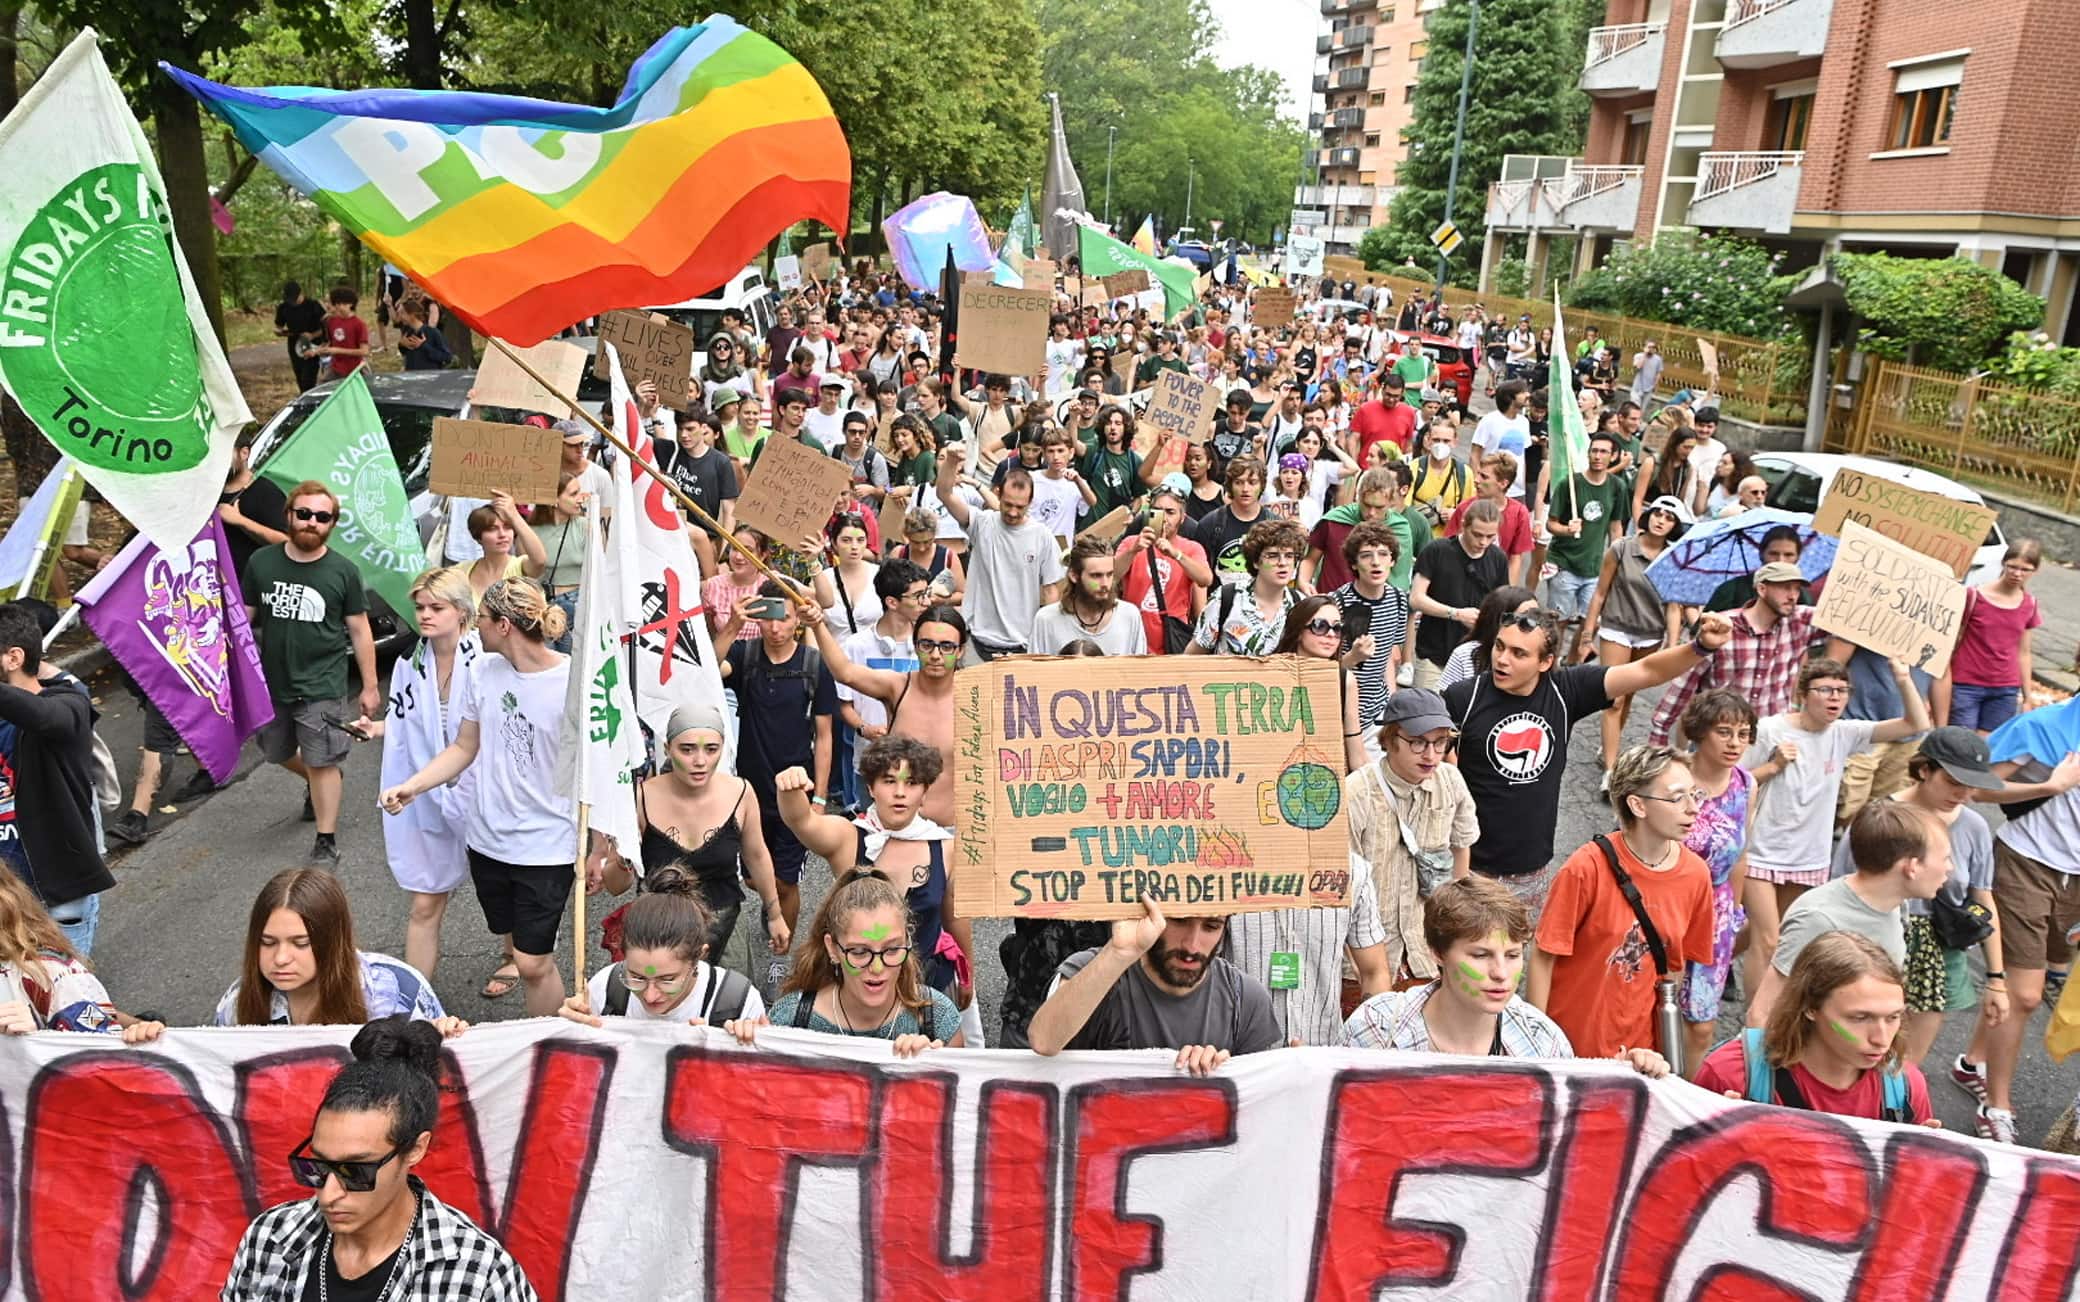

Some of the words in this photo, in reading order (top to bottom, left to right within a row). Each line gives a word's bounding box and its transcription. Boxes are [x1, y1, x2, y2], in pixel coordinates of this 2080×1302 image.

[0, 176, 122, 348] FRIDAYS
[646, 350, 675, 369] OVER
[1167, 392, 1179, 408] TO
[51, 385, 173, 463] Torino
[1832, 472, 1863, 498] NO
[261, 590, 300, 608] NORD
[272, 580, 304, 598] THE
[271, 604, 300, 621] EST
[1004, 673, 1043, 741] IN
[1049, 683, 1201, 740] QUESTA
[1202, 681, 1315, 736] TERRA
[999, 747, 1033, 782] DI
[1037, 741, 1127, 781] ASPRI
[1009, 870, 1086, 906] STOP
[1104, 870, 1180, 905] TERRA
[1186, 872, 1225, 903] DEI
[1230, 871, 1305, 900] FUOCHI
